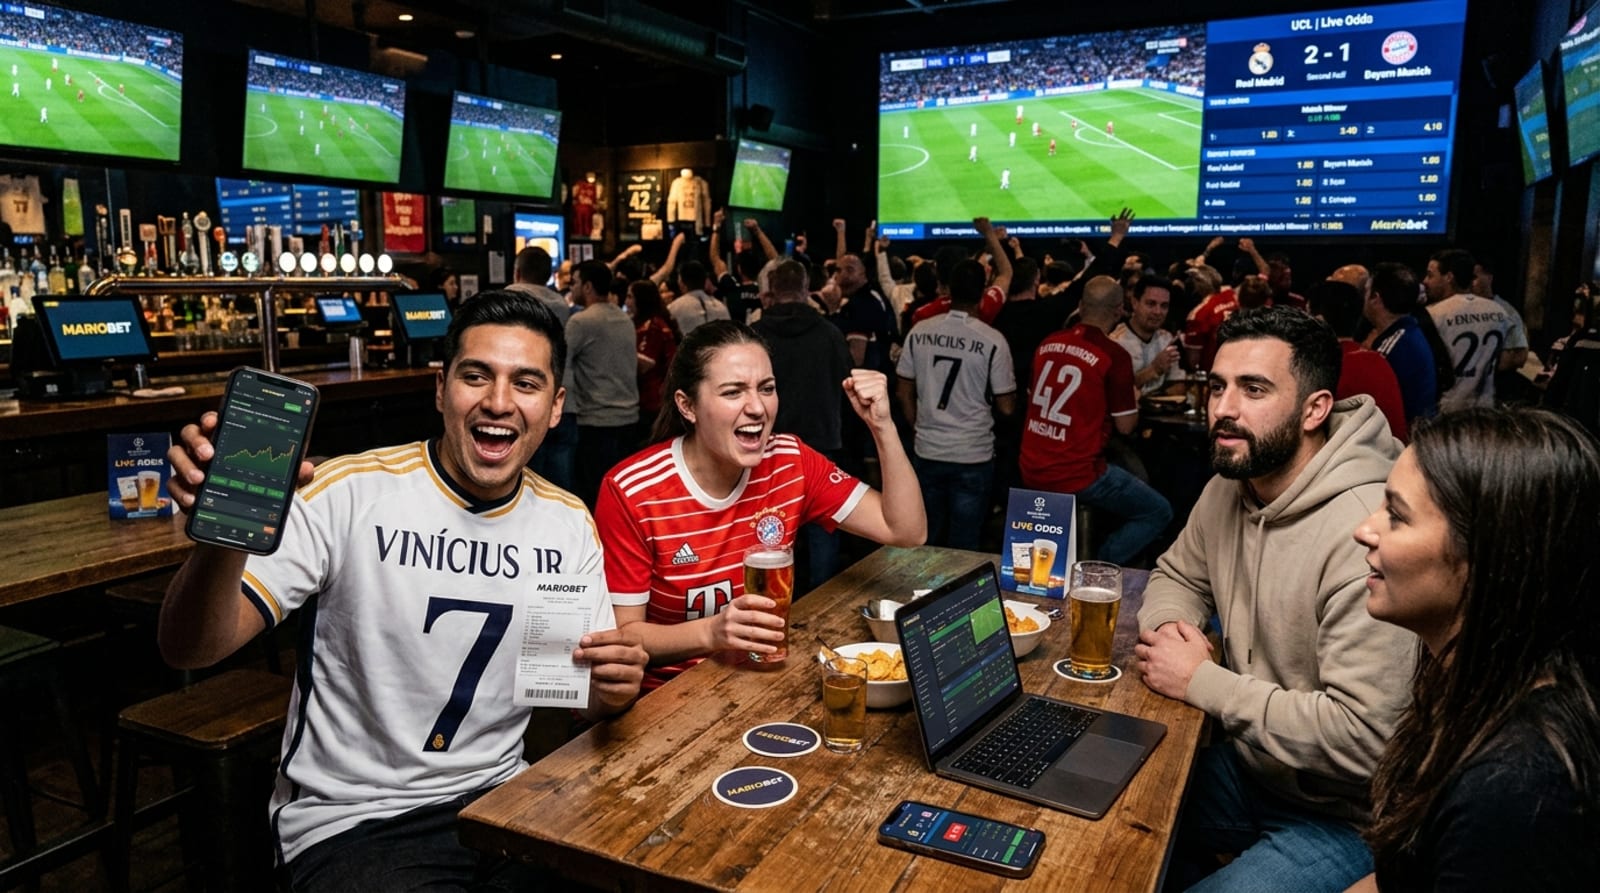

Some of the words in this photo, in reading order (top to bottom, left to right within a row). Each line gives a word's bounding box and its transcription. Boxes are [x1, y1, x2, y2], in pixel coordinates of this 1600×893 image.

[1291, 18, 1313, 31] UCL
[1320, 16, 1343, 28] Live
[1304, 45, 1319, 65] 2
[1339, 42, 1350, 62] 1
[629, 191, 650, 210] 42
[933, 355, 962, 411] 7
[1032, 361, 1083, 426] 42
[1034, 524, 1063, 535] ODDS
[375, 525, 520, 579] VINÍCIUS
[536, 584, 588, 593] MARIOBET
[423, 596, 514, 752] 7
